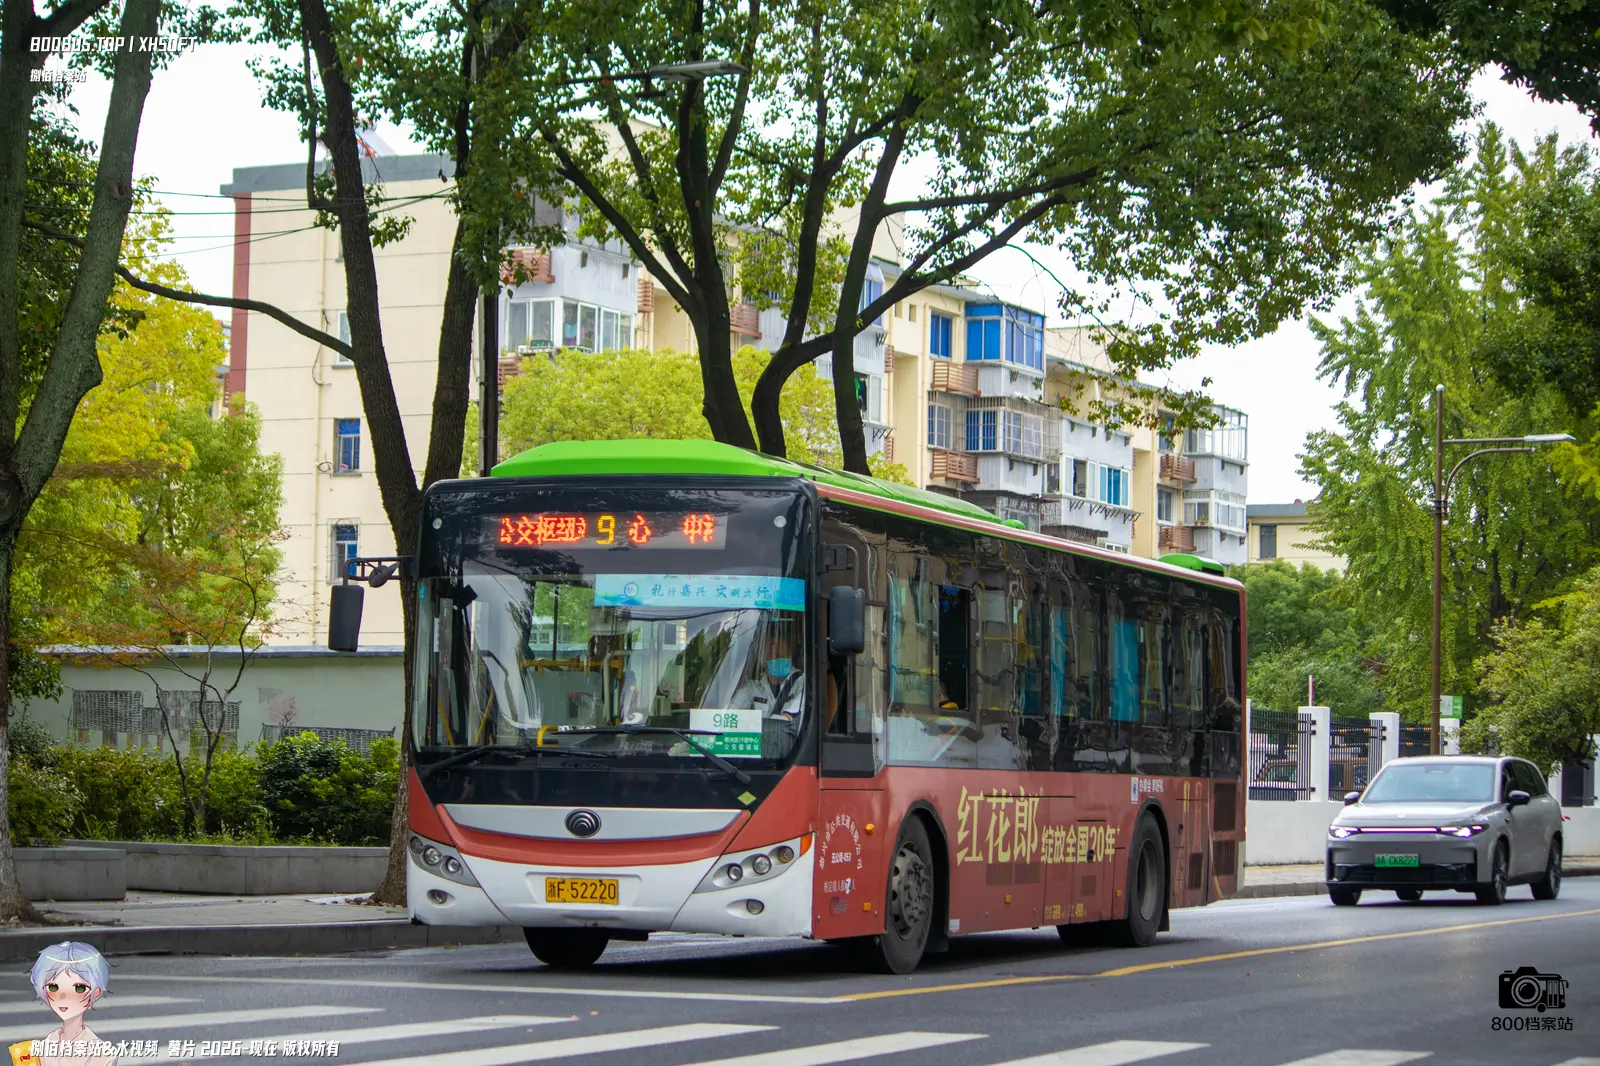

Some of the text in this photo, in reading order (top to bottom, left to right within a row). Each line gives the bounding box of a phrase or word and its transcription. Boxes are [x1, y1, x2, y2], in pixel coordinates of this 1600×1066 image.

[596, 515, 616, 545] 9
[712, 713, 739, 729] 9路
[956, 785, 1040, 867] 红花郎
[1040, 823, 1117, 864] 绽放全国20年
